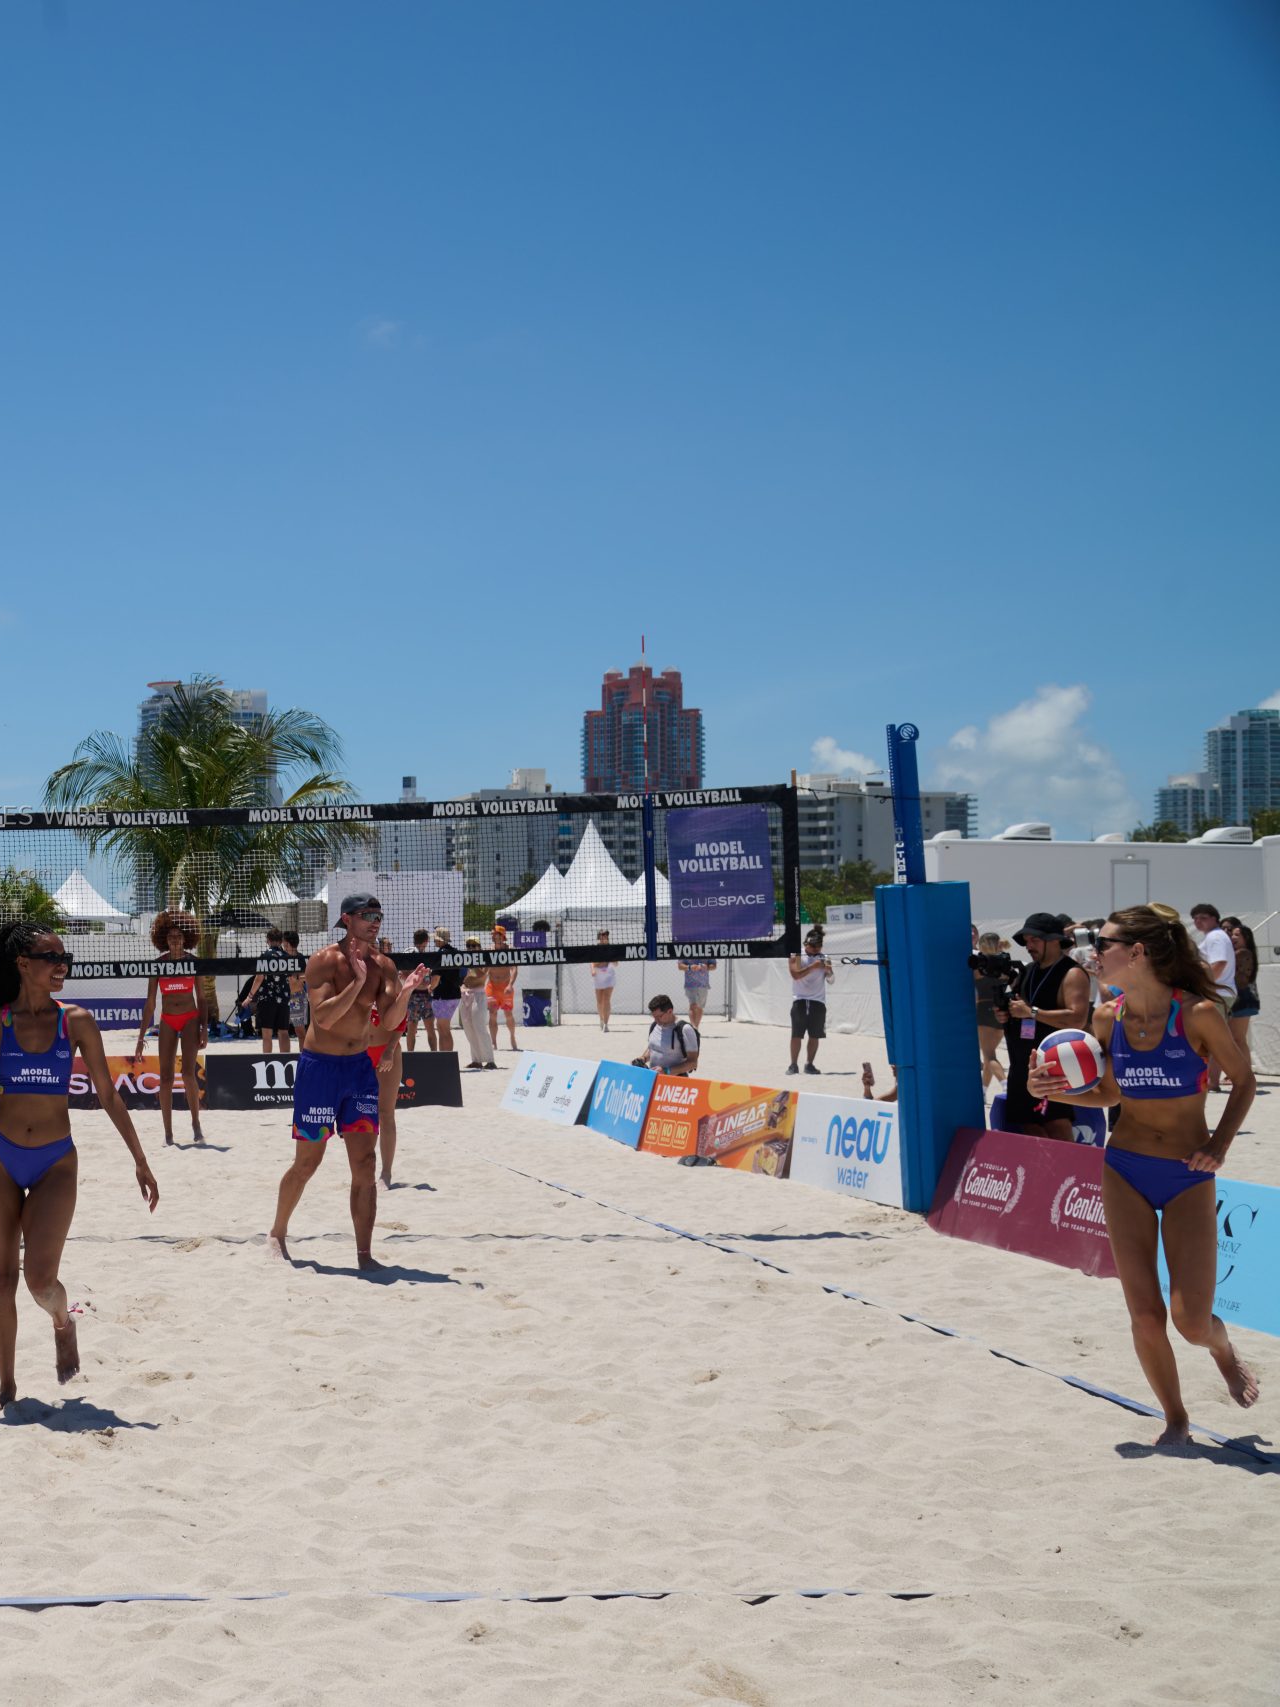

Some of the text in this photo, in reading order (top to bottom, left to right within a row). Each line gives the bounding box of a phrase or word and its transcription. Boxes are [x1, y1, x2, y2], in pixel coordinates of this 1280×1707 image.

[665, 788, 742, 807] VOLLEYBALL
[248, 806, 373, 823] MODEL VOLLEYBALL
[432, 799, 558, 817] MODEL VOLLEYBALL
[65, 811, 190, 827] MODEL VOLLEYBALL
[694, 840, 744, 857] MODEL
[678, 856, 763, 873] VOLLEYBALL
[680, 894, 766, 909] CLUBSPACE
[520, 935, 540, 943] EXIT
[440, 949, 567, 968] MODEL VOLLEYBALL
[625, 943, 751, 960] MOEL VOLLEYBALL
[71, 961, 197, 978] MODEL VOLLEYBALL
[256, 958, 301, 973] MODEL
[88, 1008, 143, 1021] OLLEYBAL
[11, 1075, 60, 1084] VOLLEYBALL
[21, 1068, 51, 1076] MODEL
[1125, 1067, 1166, 1078] MODEL
[1115, 1077, 1183, 1087] VOLLEYBALL
[254, 1092, 276, 1102] does
[604, 1079, 645, 1126] OnlyFans
[654, 1084, 699, 1106] LINEAR
[308, 1106, 334, 1116] MODEL
[301, 1114, 336, 1124] VOLLEYBA
[714, 1102, 768, 1137] LINEAR
[984, 1162, 1004, 1171] TEQUILA
[837, 1166, 869, 1189] water
[964, 1167, 1012, 1202] Centinela
[1086, 1182, 1102, 1191] TEQU
[987, 1204, 1002, 1212] LEGACY
[1070, 1222, 1086, 1231] YEARS
